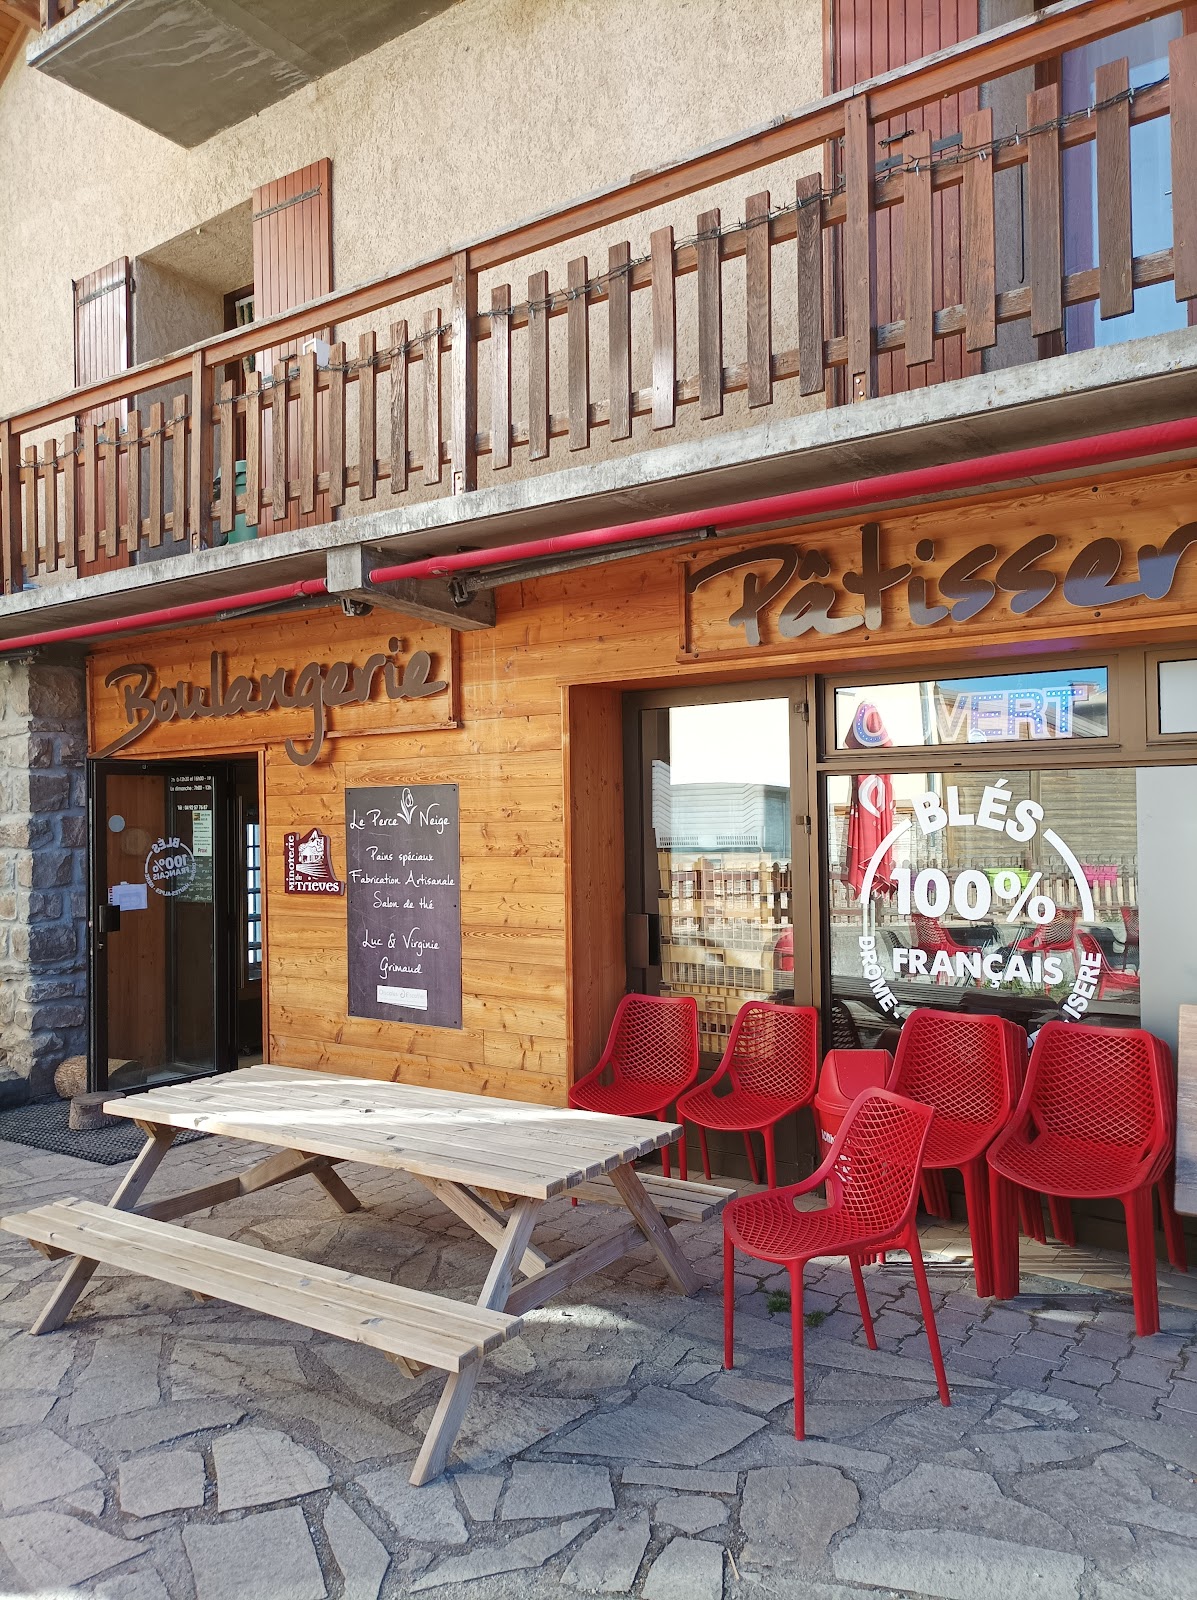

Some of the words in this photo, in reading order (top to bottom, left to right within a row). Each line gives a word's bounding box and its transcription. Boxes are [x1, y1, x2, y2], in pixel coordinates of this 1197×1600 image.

[89, 636, 448, 767] Boulangerie
[350, 809, 365, 829] Le
[366, 809, 399, 827] Perce
[420, 803, 450, 834] Neige
[910, 778, 1045, 842] BLÉS
[365, 846, 393, 862] Pains
[398, 851, 434, 866] spéciaux
[349, 869, 401, 886] Fabrication
[405, 870, 455, 887] Artisanale
[889, 867, 1056, 925] 100%
[373, 890, 399, 909] Salon
[403, 898, 415, 909] de
[419, 897, 435, 909] thé
[362, 929, 383, 948] Luc
[387, 933, 397, 949] &
[403, 927, 440, 956] Virginie
[379, 956, 423, 980] Grimaud
[858, 936, 899, 1013] DRÔME
[892, 947, 1064, 990] FRANÇAIS
[1062, 951, 1102, 1020] ISÈRE
